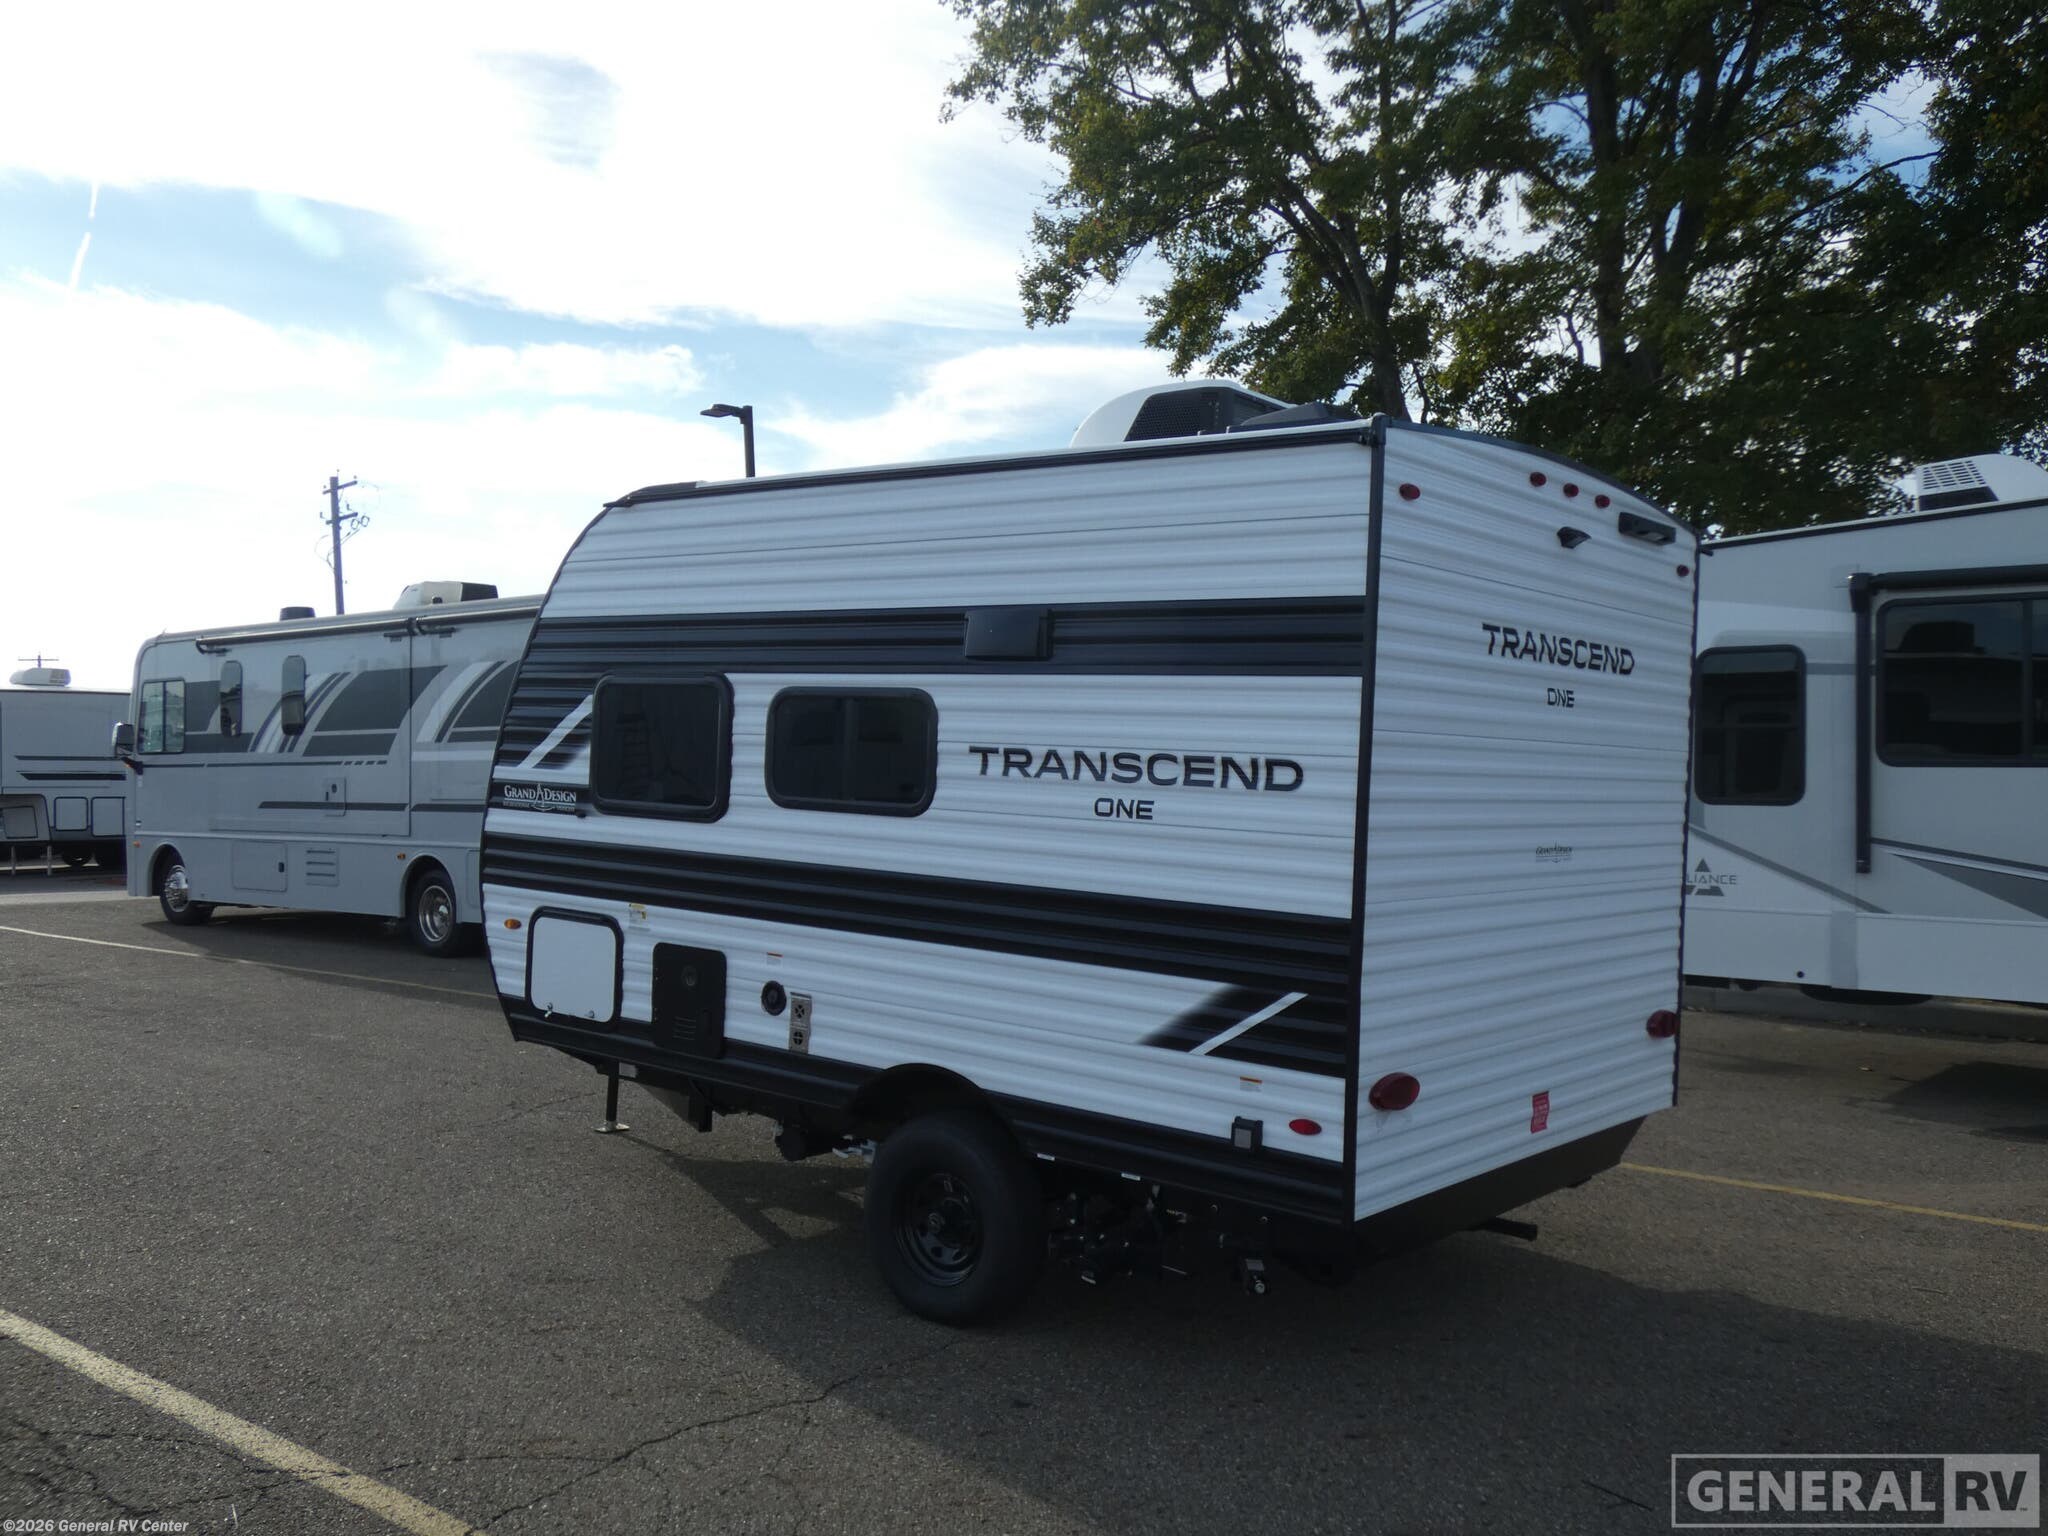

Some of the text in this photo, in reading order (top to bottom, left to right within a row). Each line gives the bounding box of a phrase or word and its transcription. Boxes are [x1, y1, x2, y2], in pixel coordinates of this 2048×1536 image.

[1482, 622, 1635, 676] TRANSCEND
[969, 745, 1304, 792] TRANSCEND
[504, 784, 577, 803] GRAND DESIGN
[1094, 797, 1155, 821] ONE
[1686, 873, 1737, 886] LIANCE
